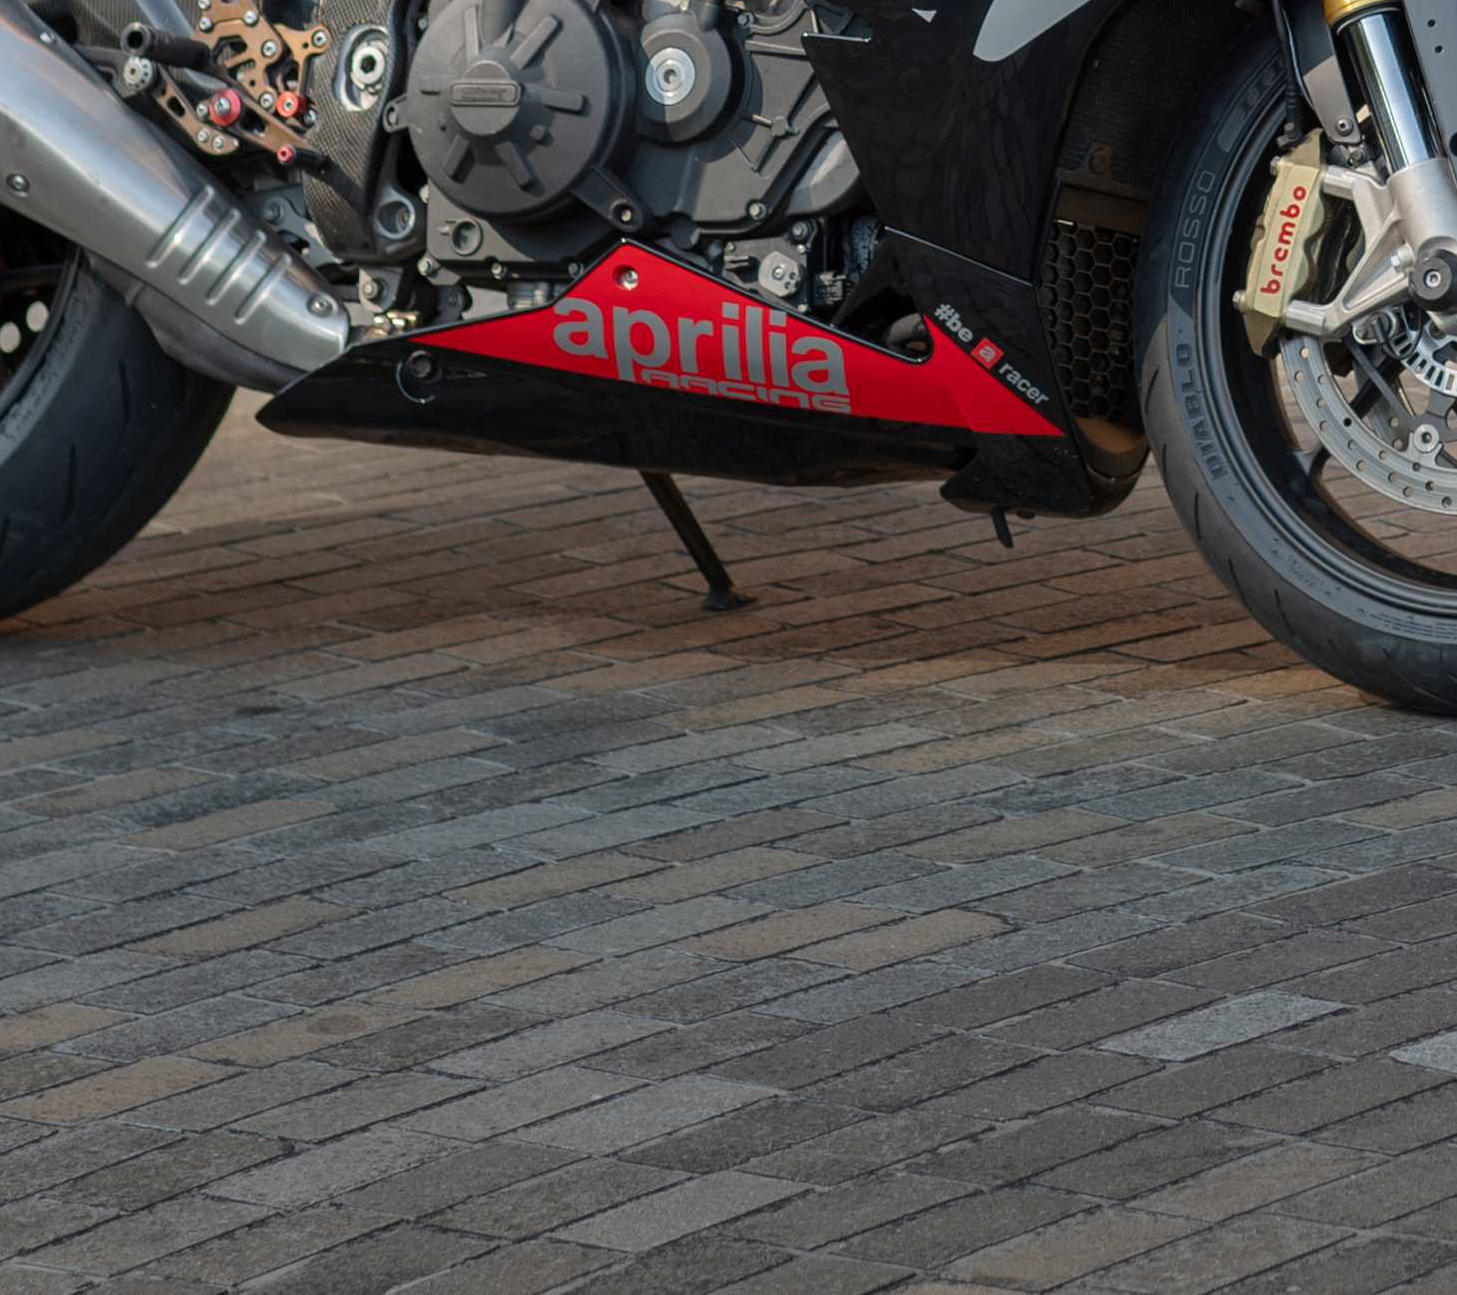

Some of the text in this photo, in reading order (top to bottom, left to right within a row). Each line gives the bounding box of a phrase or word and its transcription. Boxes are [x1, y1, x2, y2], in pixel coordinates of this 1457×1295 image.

[1174, 170, 1216, 289] ROSSO
[1260, 186, 1307, 295] brembo
[553, 297, 849, 395] aprilia
[934, 303, 974, 343] #be
[998, 363, 1050, 404] racer
